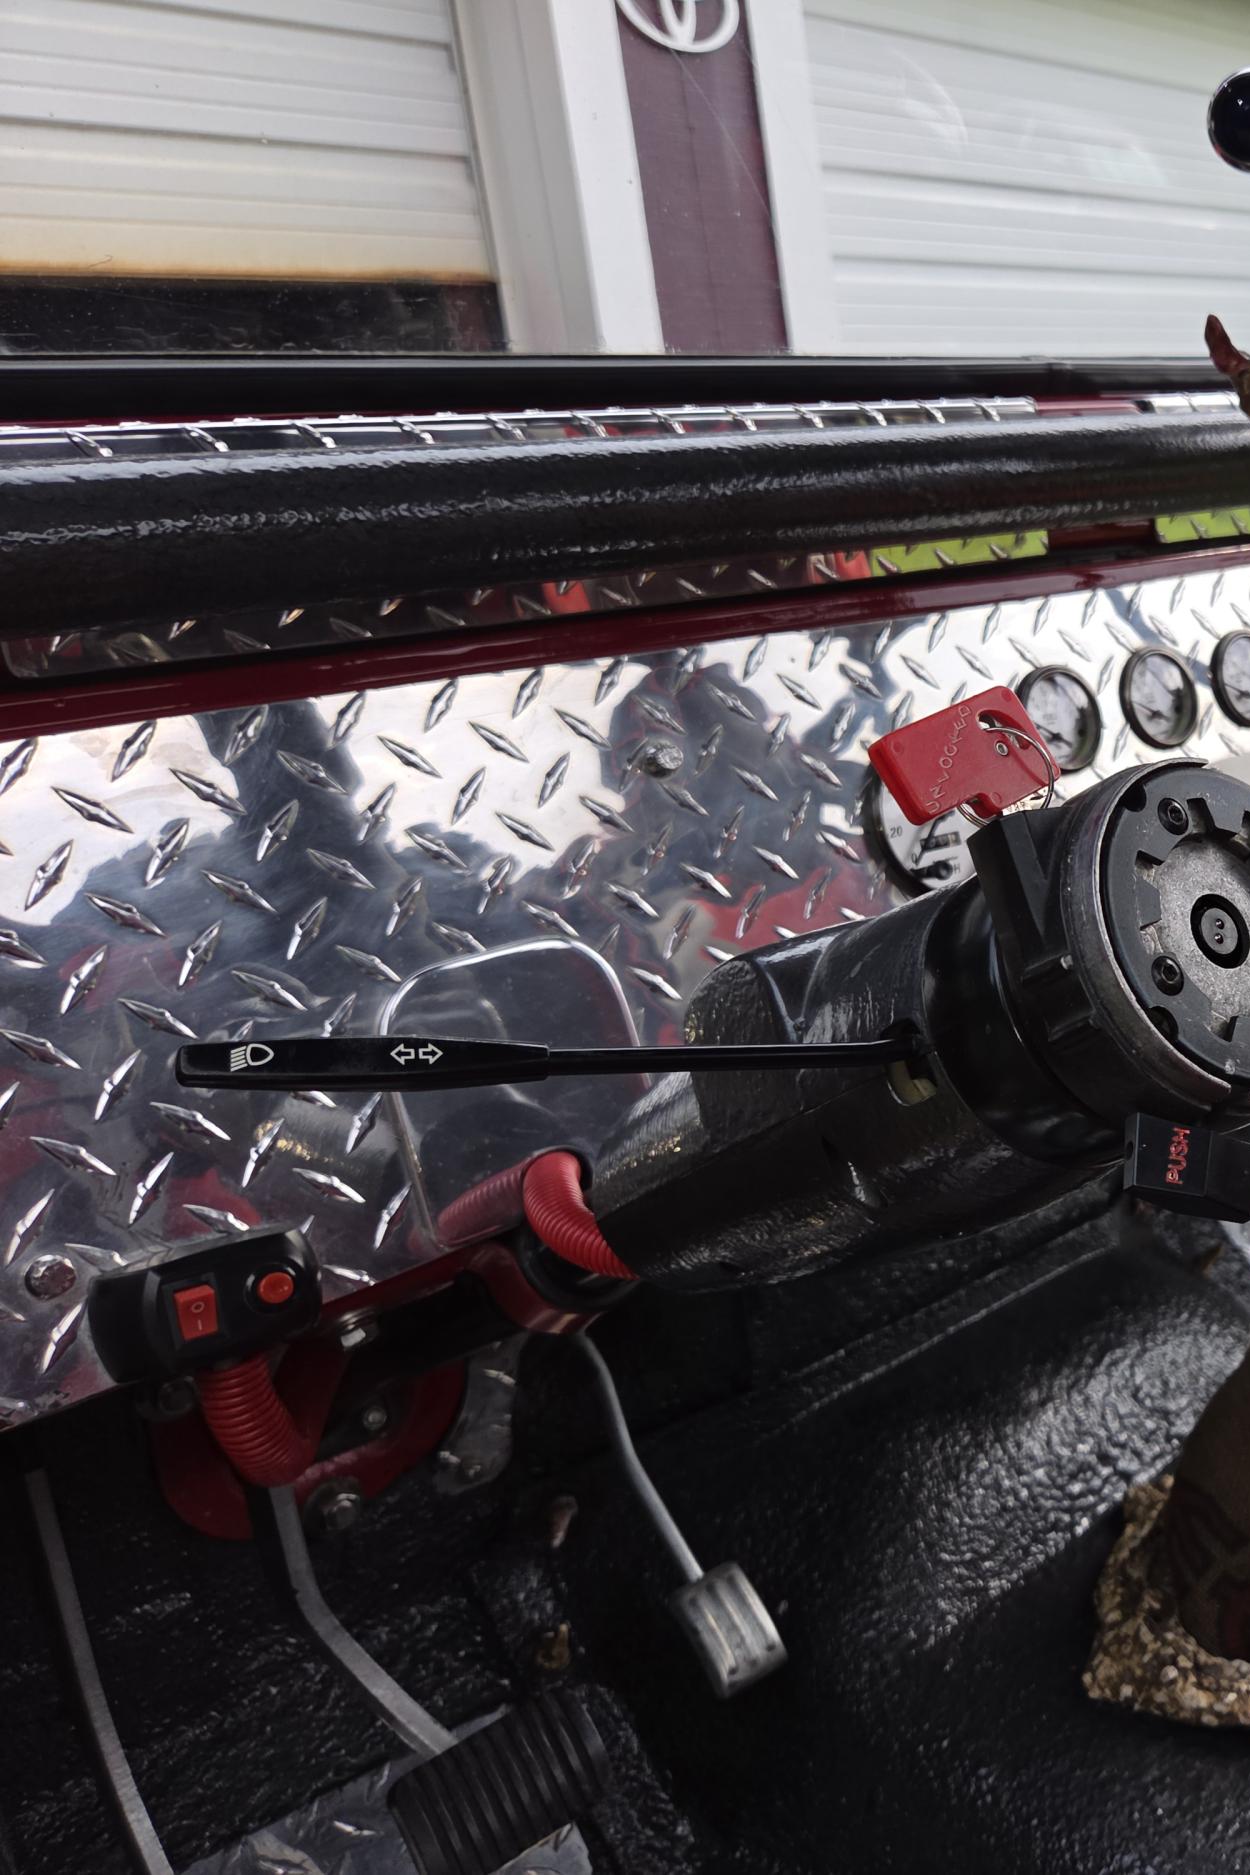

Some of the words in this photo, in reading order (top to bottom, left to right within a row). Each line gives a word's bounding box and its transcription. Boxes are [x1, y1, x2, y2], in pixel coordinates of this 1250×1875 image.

[925, 704, 972, 814] UNLOCKED
[890, 826, 903, 838] 20
[1165, 1126, 1191, 1185] PUSH
